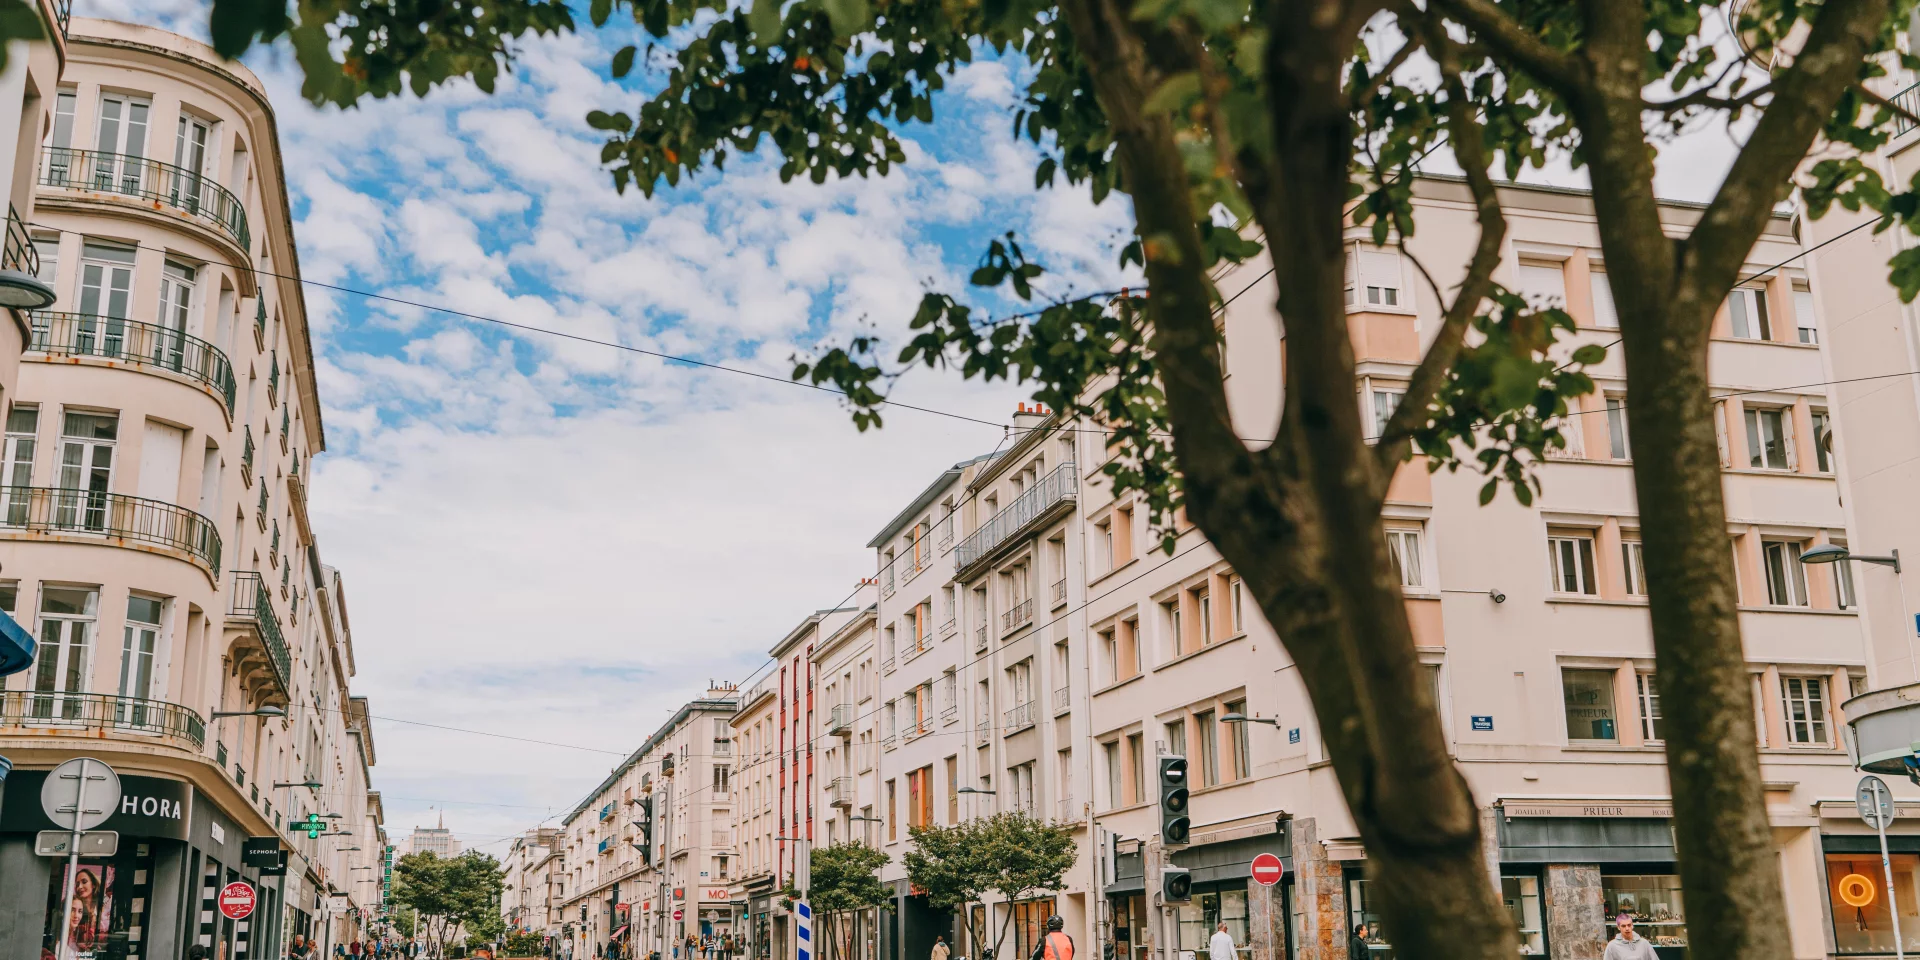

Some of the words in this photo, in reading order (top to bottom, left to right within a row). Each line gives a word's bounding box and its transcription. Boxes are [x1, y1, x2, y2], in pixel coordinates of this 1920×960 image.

[1570, 708, 1608, 718] PRIEUR
[121, 795, 181, 820] HORA
[1584, 807, 1623, 816] PRIEUR
